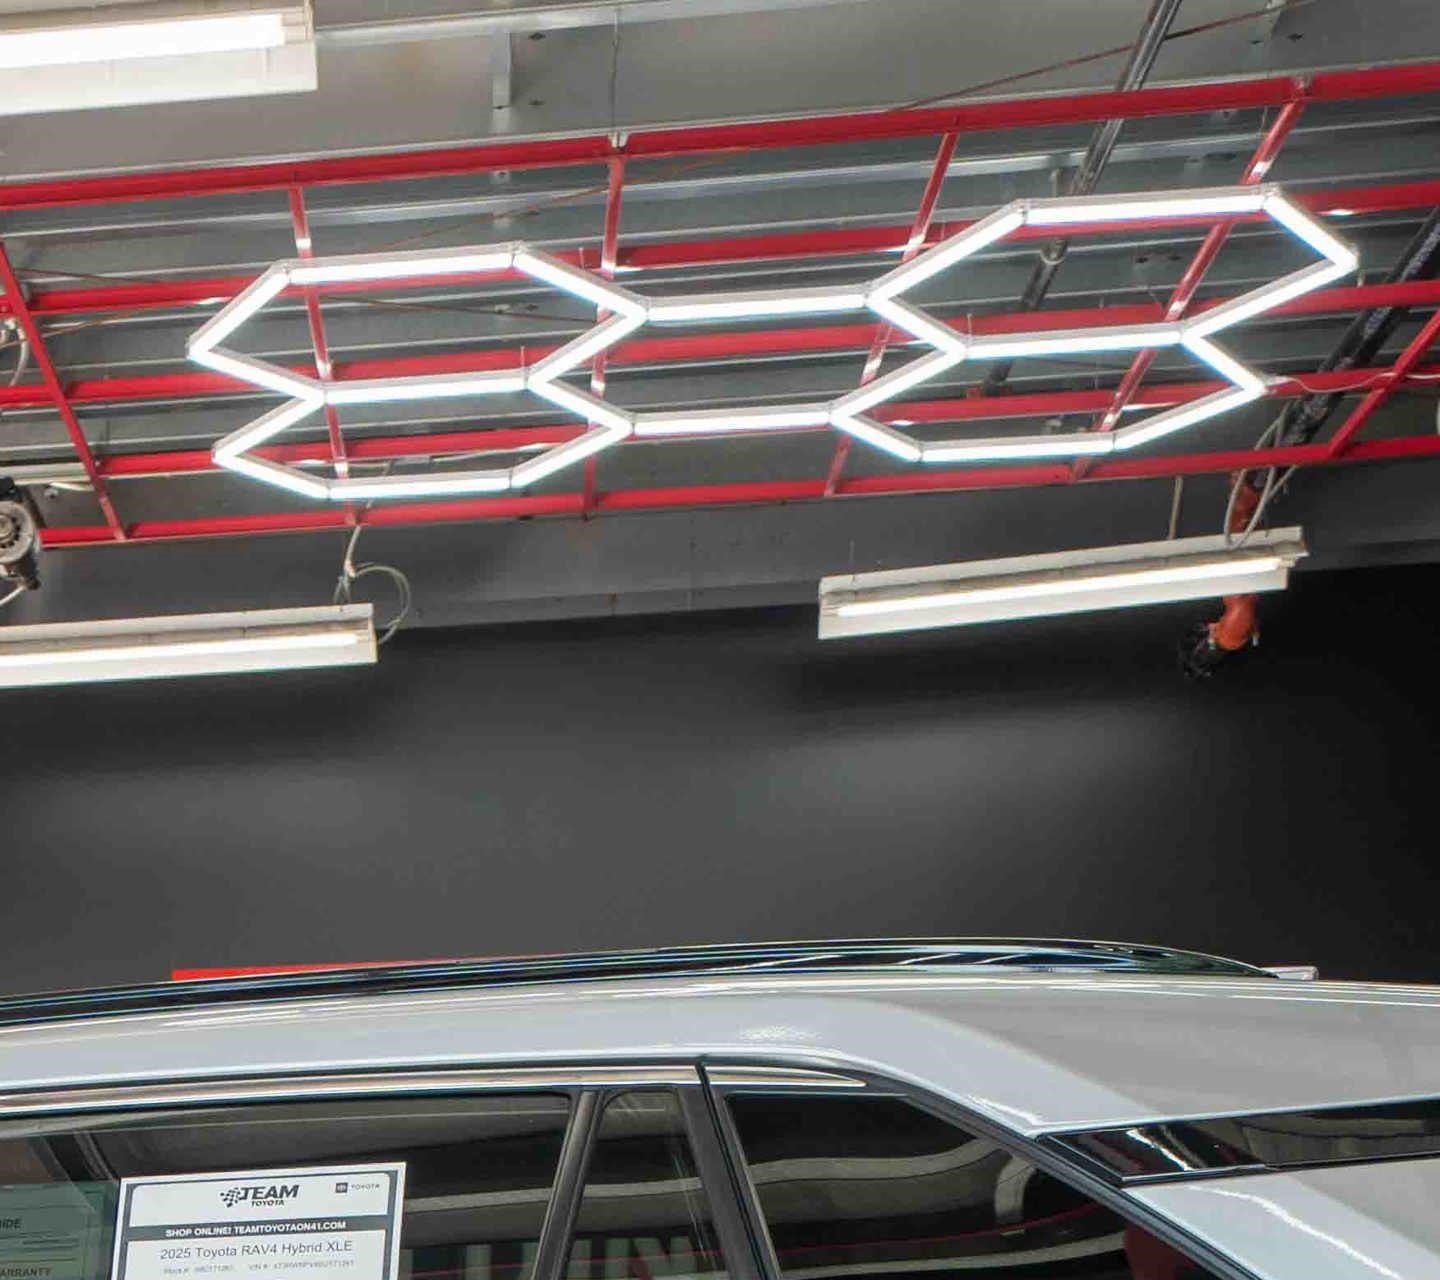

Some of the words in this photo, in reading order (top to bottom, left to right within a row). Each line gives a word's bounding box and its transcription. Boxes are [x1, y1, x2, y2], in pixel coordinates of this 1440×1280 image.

[240, 1184, 299, 1201] TEAM
[350, 1183, 381, 1191] TOYOTA
[251, 1199, 285, 1207] TOYOTA
[165, 1228, 192, 1238] SHOP
[194, 1226, 232, 1237] ONLINE!
[233, 1221, 347, 1236] TEAMTOYOTAON41.COM
[160, 1247, 192, 1260] 2025
[196, 1246, 238, 1260] Toyota
[241, 1243, 278, 1256] RAV4
[281, 1241, 322, 1256] Hybrid
[326, 1240, 353, 1252] XLE
